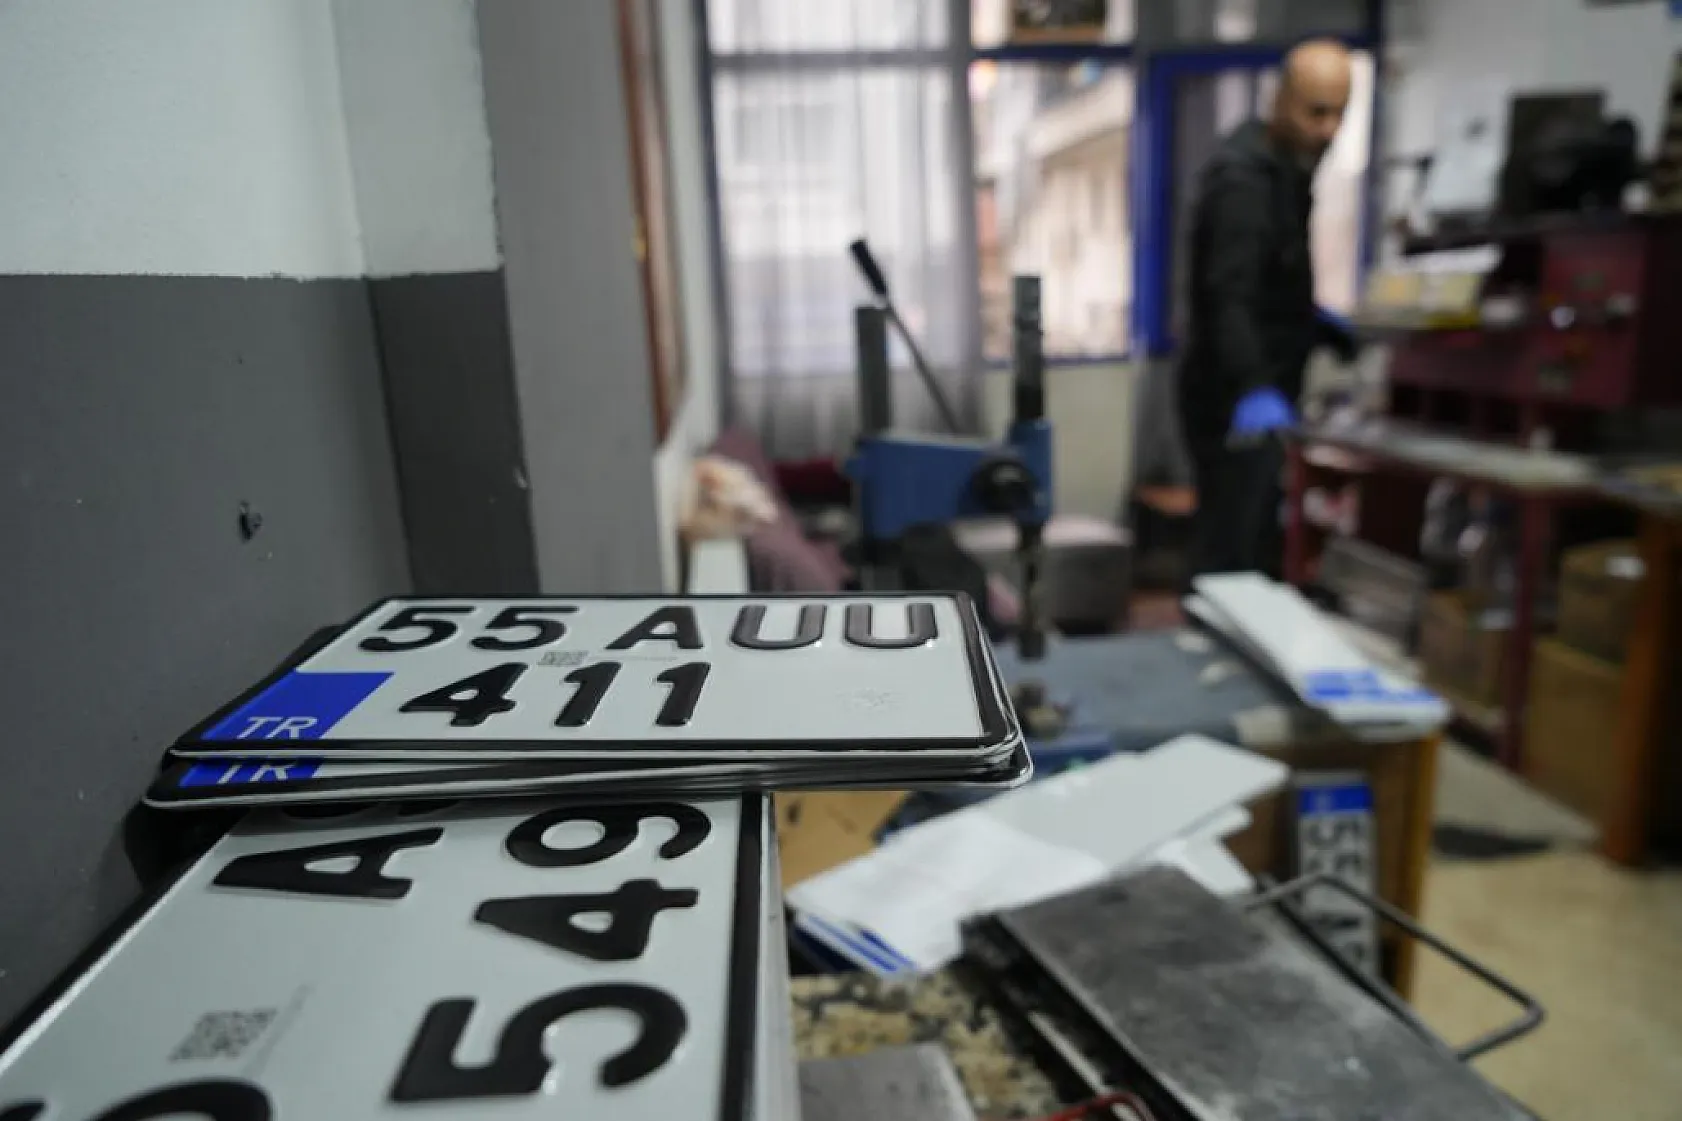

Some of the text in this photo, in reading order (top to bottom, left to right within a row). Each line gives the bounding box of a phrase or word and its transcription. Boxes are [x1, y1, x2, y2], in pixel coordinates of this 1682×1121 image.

[359, 605, 938, 653] 55 AUU
[399, 662, 712, 728] 411
[236, 716, 317, 739] TR
[385, 802, 711, 1104] 549
